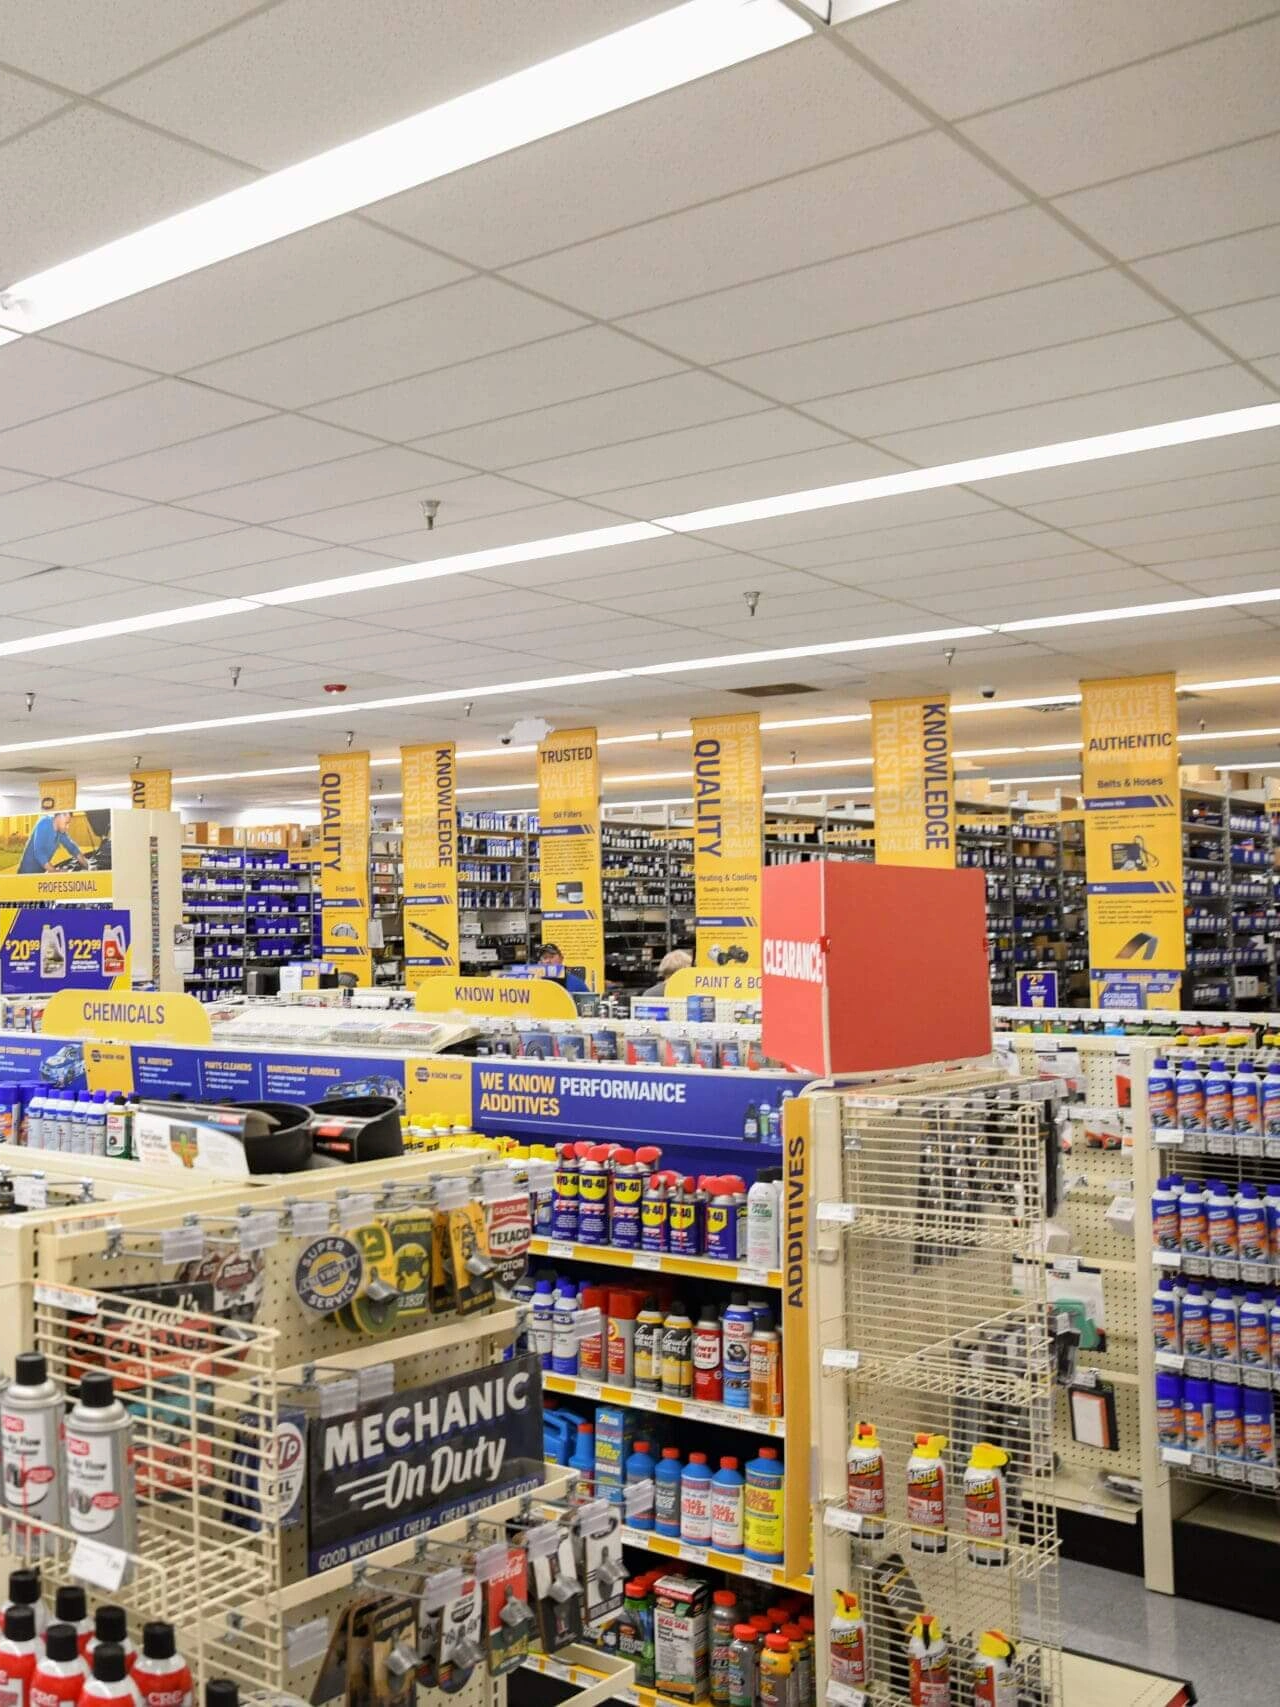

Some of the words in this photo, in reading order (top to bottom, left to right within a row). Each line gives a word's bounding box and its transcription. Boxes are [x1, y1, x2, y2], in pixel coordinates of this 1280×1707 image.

[1089, 733, 1172, 751] AUTHENTIC
[540, 747, 593, 764] TRUSTED
[876, 708, 897, 816] TRUSTED
[923, 703, 949, 850] KNOWLEDGE
[1098, 780, 1120, 789] Belts
[1124, 779, 1131, 787] &
[1134, 777, 1163, 786] Hoses
[694, 739, 722, 858] QUALITY
[436, 749, 453, 868] KNOWLEDGE
[321, 772, 341, 872] QUALITY
[38, 880, 97, 893] PROFESSIONAL
[763, 938, 824, 984] CLEARANCE
[695, 975, 730, 989] PAINT
[734, 976, 744, 989] &
[455, 987, 494, 1003] KNOW
[499, 988, 530, 1004] HOW
[83, 1002, 165, 1025] CHEMICALS
[267, 1065, 308, 1076] MAINTENANCE
[480, 1072, 503, 1090] WE
[508, 1075, 555, 1095] KNOW
[560, 1076, 686, 1103] PERFORMANCE
[480, 1094, 560, 1116] ADDITIVES
[581, 1177, 606, 1190] WD-40
[615, 1180, 640, 1193] WD-40
[495, 1203, 528, 1214] GASOLINE
[788, 1135, 805, 1308] ADDITIVES
[491, 1228, 530, 1245] TEXACO
[302, 1240, 345, 1267] SUPER
[503, 1272, 517, 1281] OIL
[308, 1277, 358, 1309] SERVICE
[324, 1372, 530, 1471] MECHANIC
[22, 1438, 40, 1446] Flow
[86, 1462, 106, 1470] Flow
[386, 1460, 427, 1509] On
[431, 1436, 506, 1495] Duty
[849, 1457, 881, 1474] BLASTER
[929, 1502, 942, 1511] PB
[319, 1547, 347, 1570] GOOD
[349, 1536, 378, 1557] WORK
[403, 1516, 430, 1537] CHEAP
[439, 1503, 466, 1524] CHEAP
[469, 1493, 493, 1513] WORK
[516, 1479, 539, 1496] GOOD
[985, 1514, 999, 1524] PB
